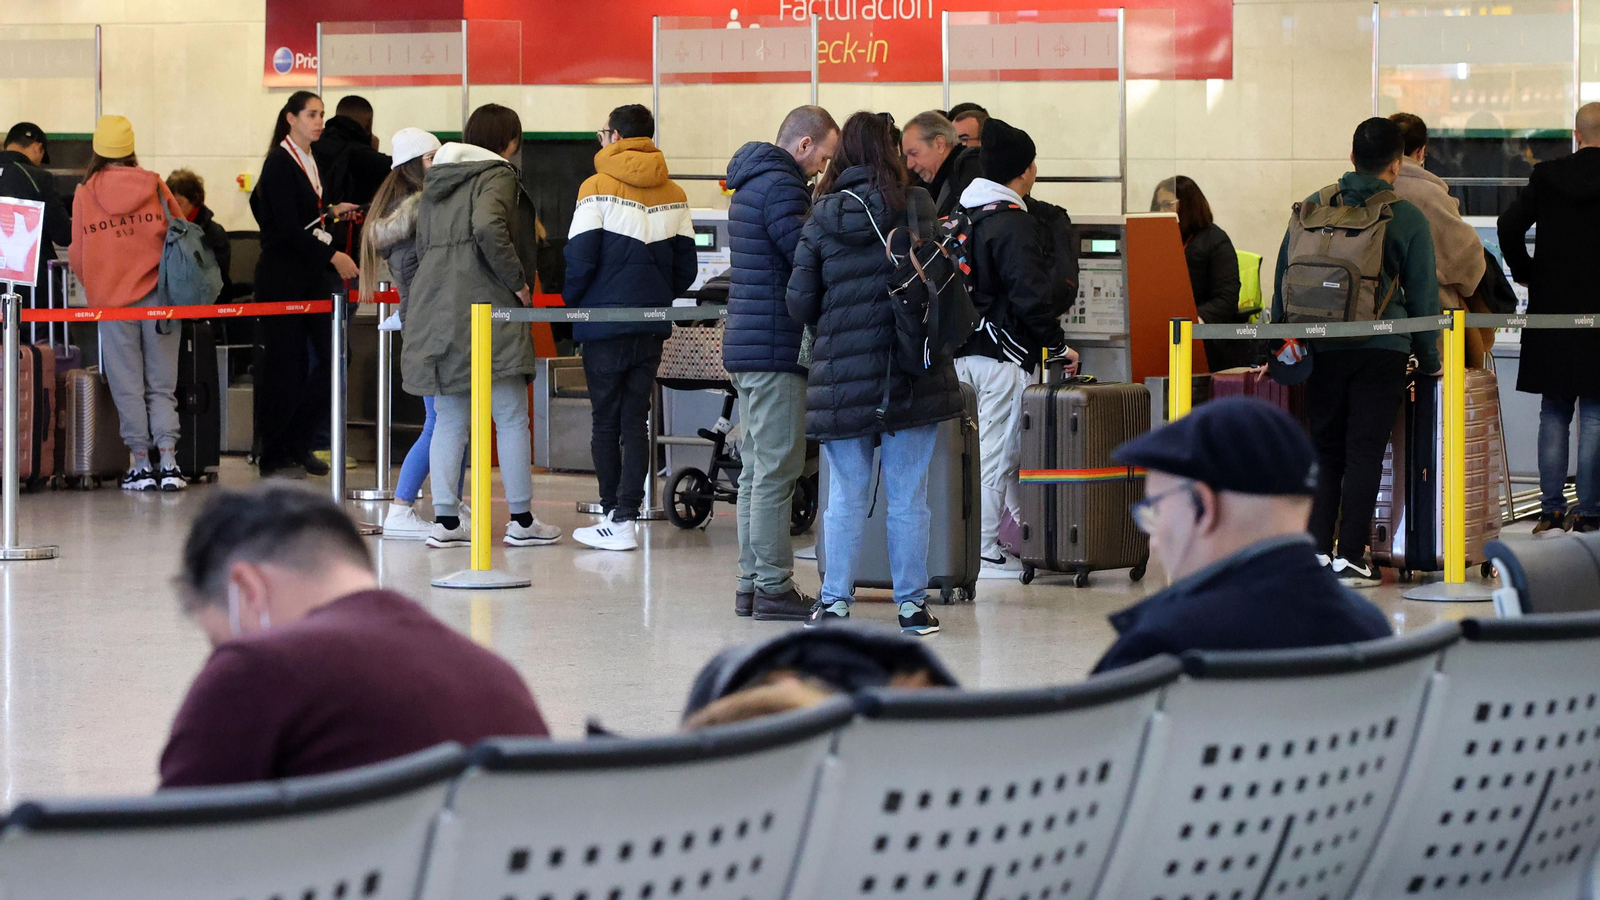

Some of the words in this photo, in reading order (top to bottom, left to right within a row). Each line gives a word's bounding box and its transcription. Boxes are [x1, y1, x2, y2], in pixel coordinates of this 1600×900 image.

[817, 32, 889, 64] eck-in
[83, 213, 163, 235] ISOLATION
[491, 309, 511, 321] ueling
[566, 309, 590, 321] vueling
[643, 309, 667, 320] vueling
[1506, 316, 1528, 328] vueling
[1574, 315, 1595, 327] vueling
[1235, 326, 1258, 338] vueling
[1305, 324, 1327, 337] vueling
[1372, 321, 1394, 333] vueling
